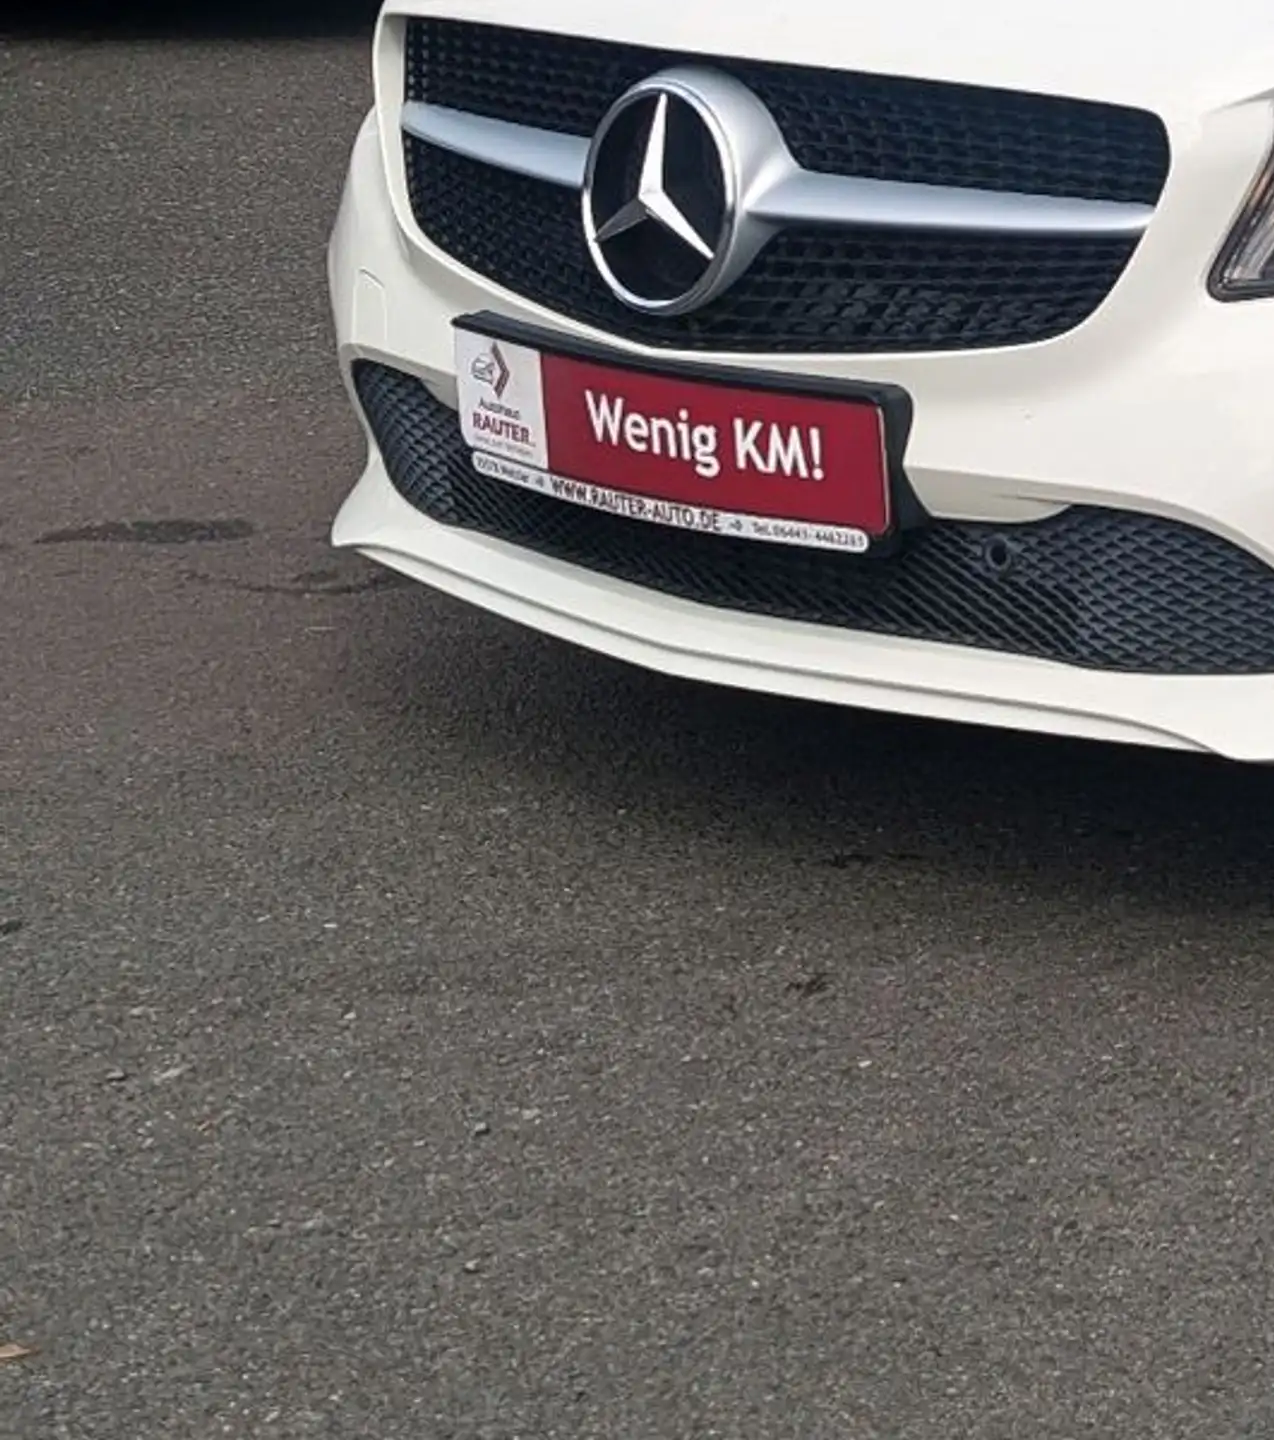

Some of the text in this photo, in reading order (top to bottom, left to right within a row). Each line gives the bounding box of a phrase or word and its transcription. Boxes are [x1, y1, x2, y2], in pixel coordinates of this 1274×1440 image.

[473, 411, 530, 443] RAUTER
[584, 389, 824, 480] Wenig KM!
[550, 475, 722, 532] WWW.RAUTER-AUTO.DE
